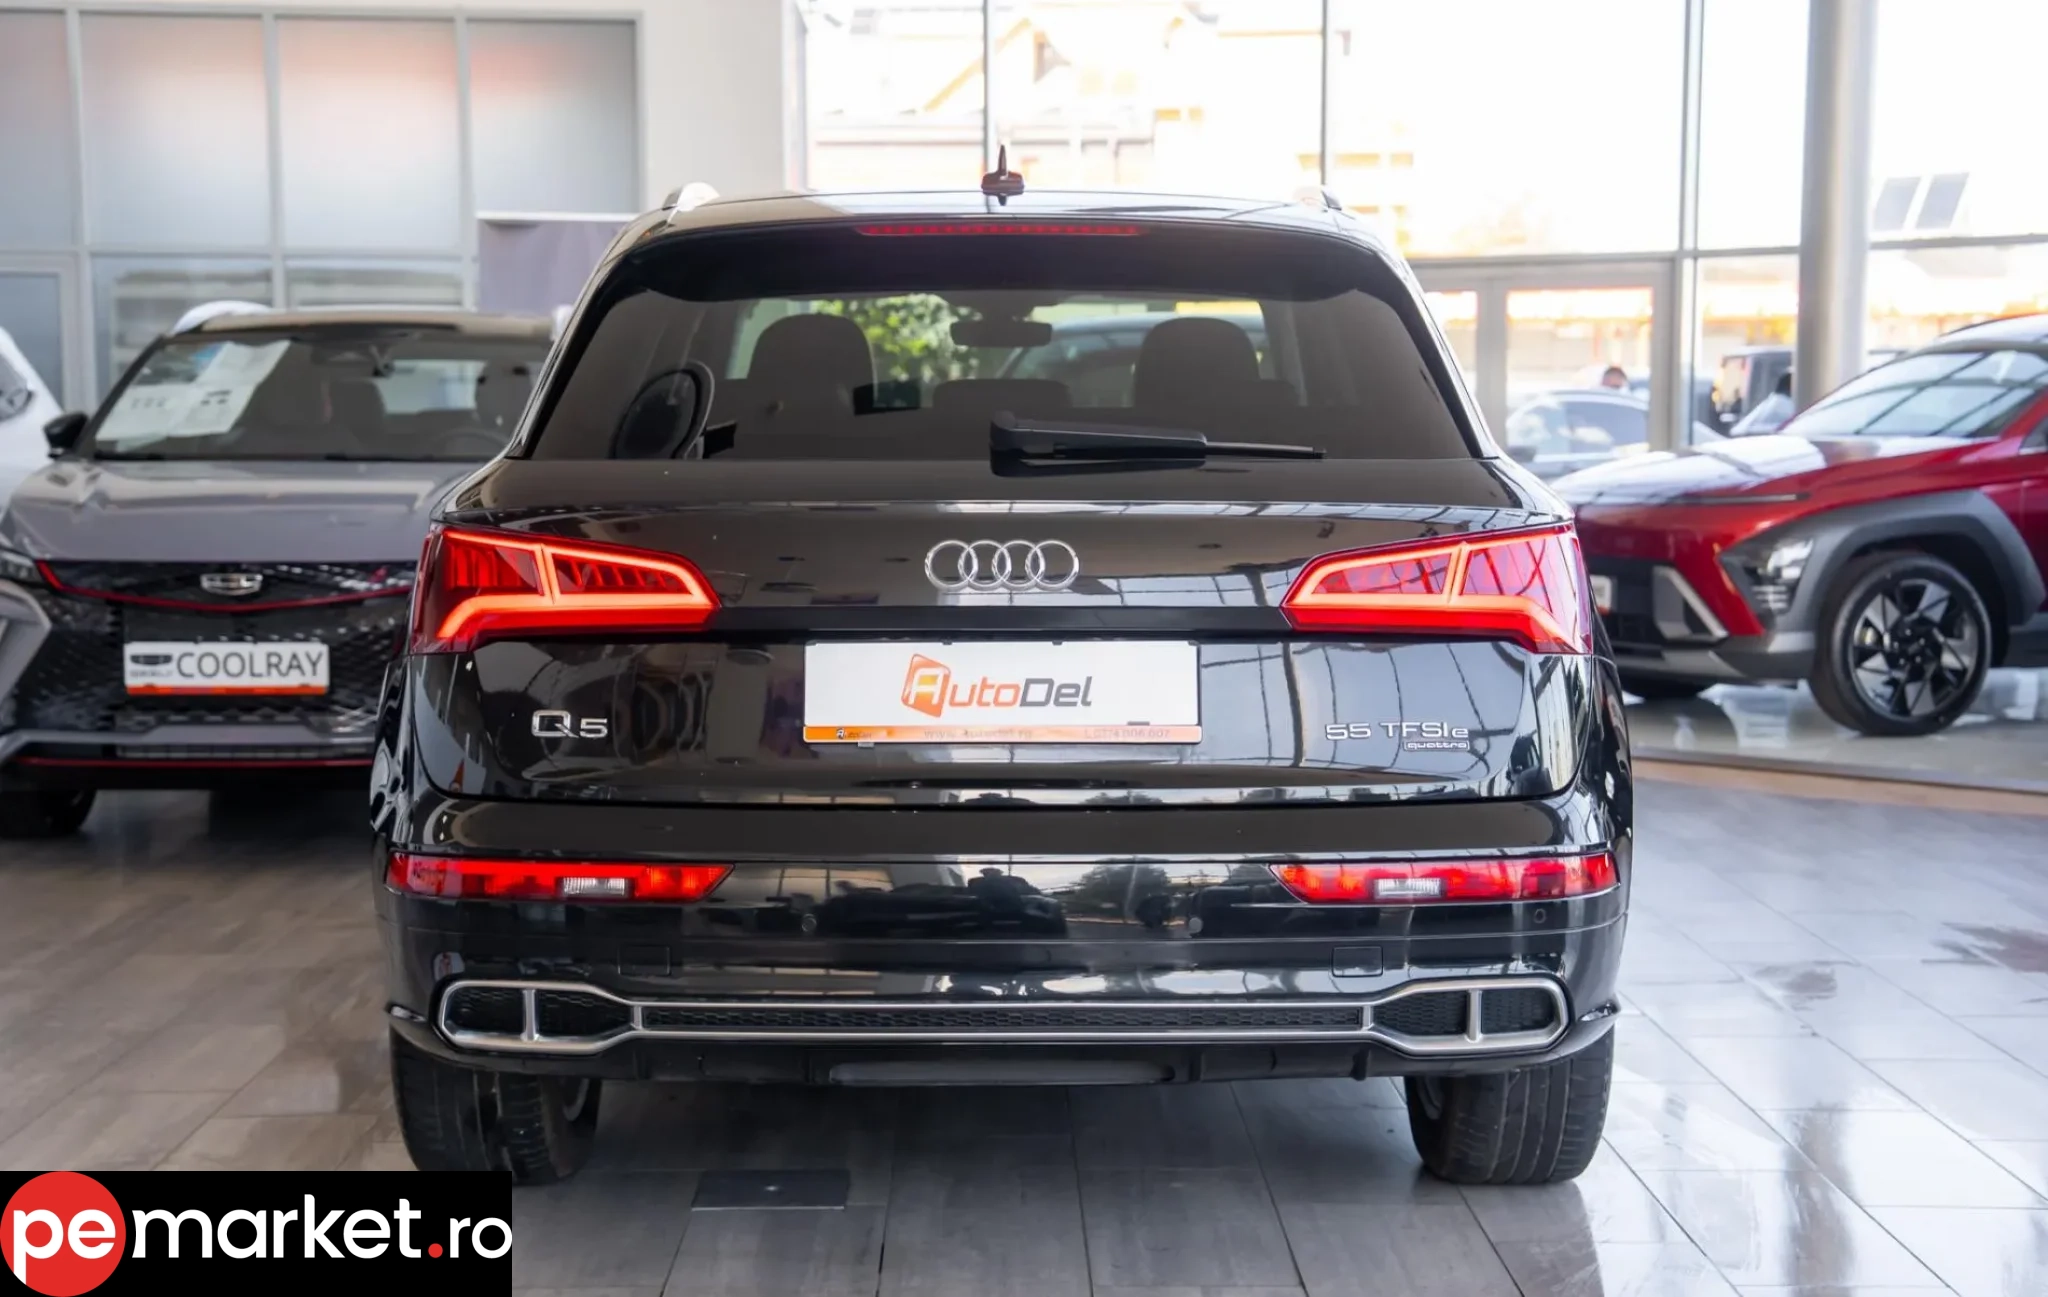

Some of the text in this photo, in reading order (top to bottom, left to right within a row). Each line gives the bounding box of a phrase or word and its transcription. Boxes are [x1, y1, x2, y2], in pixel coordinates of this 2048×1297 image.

[176, 652, 323, 678] COOLRAY
[904, 663, 1093, 707] AutoDel
[531, 709, 608, 738] Q5
[1325, 723, 1372, 740] 55
[1406, 741, 1469, 750] quattro
